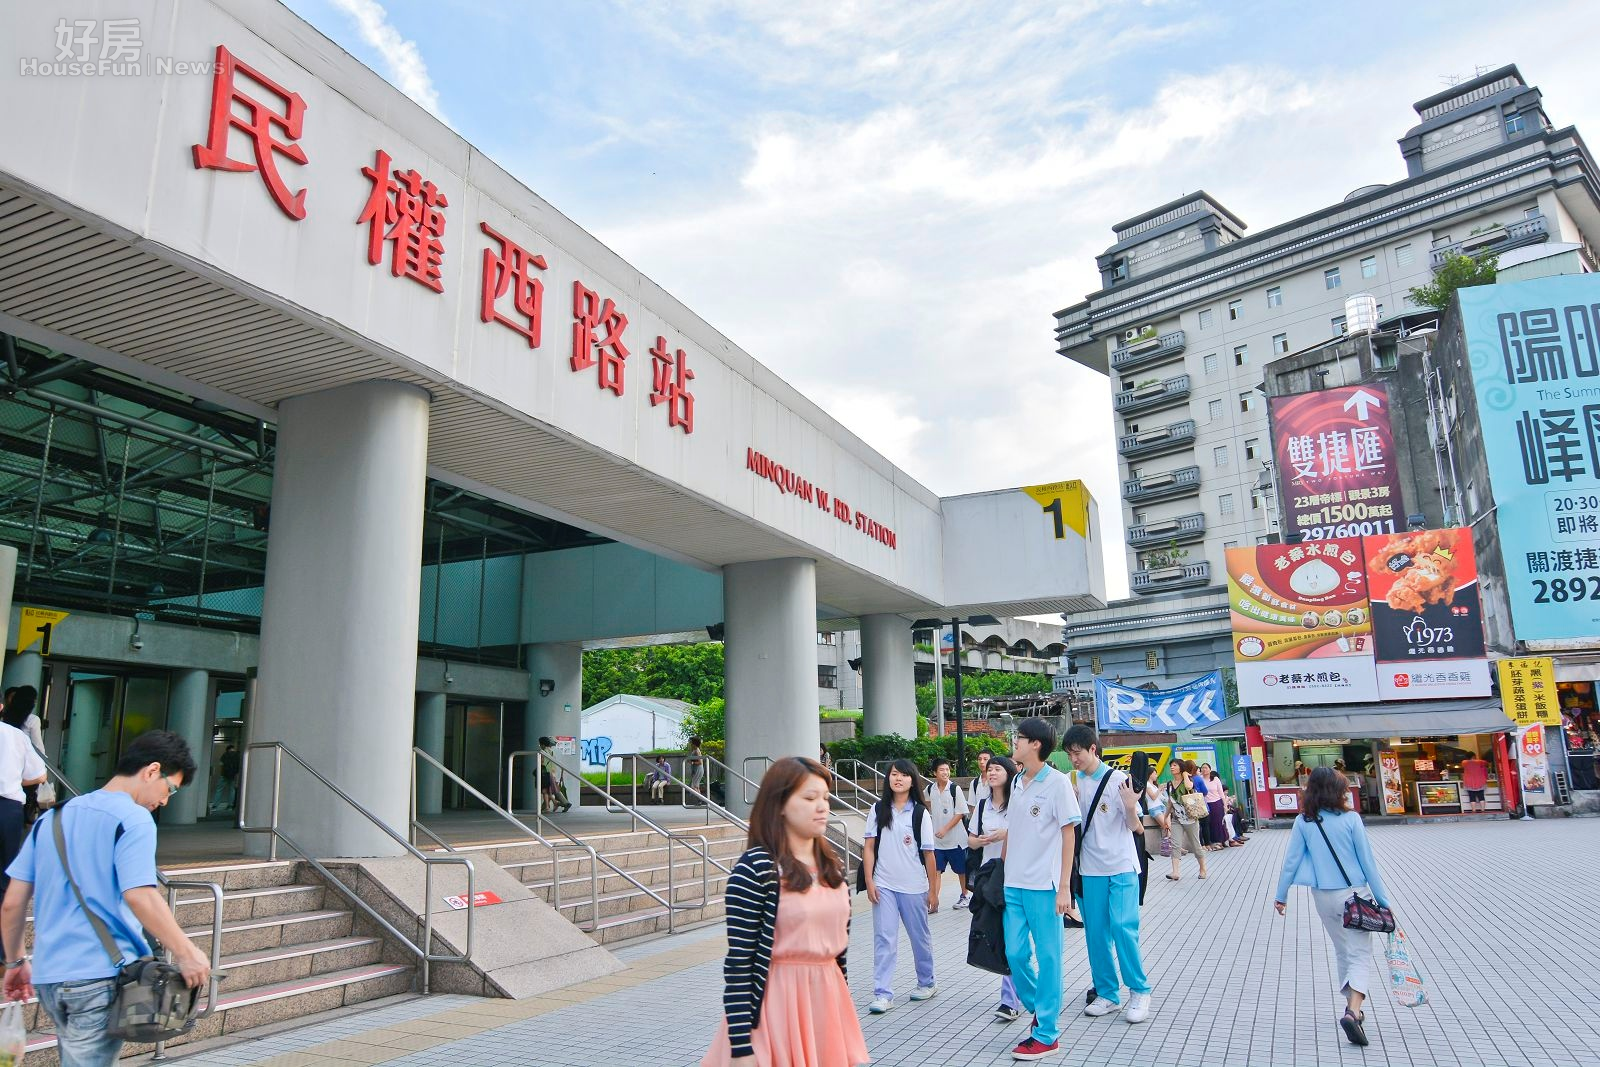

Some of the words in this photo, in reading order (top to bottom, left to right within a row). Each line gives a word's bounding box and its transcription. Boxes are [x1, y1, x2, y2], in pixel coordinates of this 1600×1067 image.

[191, 43, 695, 435] 民權西路站
[1536, 389, 1561, 401] The
[1287, 426, 1386, 481] 雙捷匯
[1516, 404, 1600, 485] 峰
[746, 447, 813, 504] MINQUAN
[815, 487, 831, 513] W.
[833, 497, 852, 525] RD.
[855, 511, 896, 550] STATION
[1043, 498, 1065, 539] 1
[1300, 519, 1396, 542] 29760011
[1274, 543, 1357, 571] 老蔡水煎包
[1526, 548, 1600, 574] 關渡捷
[36, 622, 52, 655] 1
[1416, 626, 1454, 647] 1973
[1279, 671, 1341, 684] 老蔡水煎包
[1107, 687, 1145, 723] P
